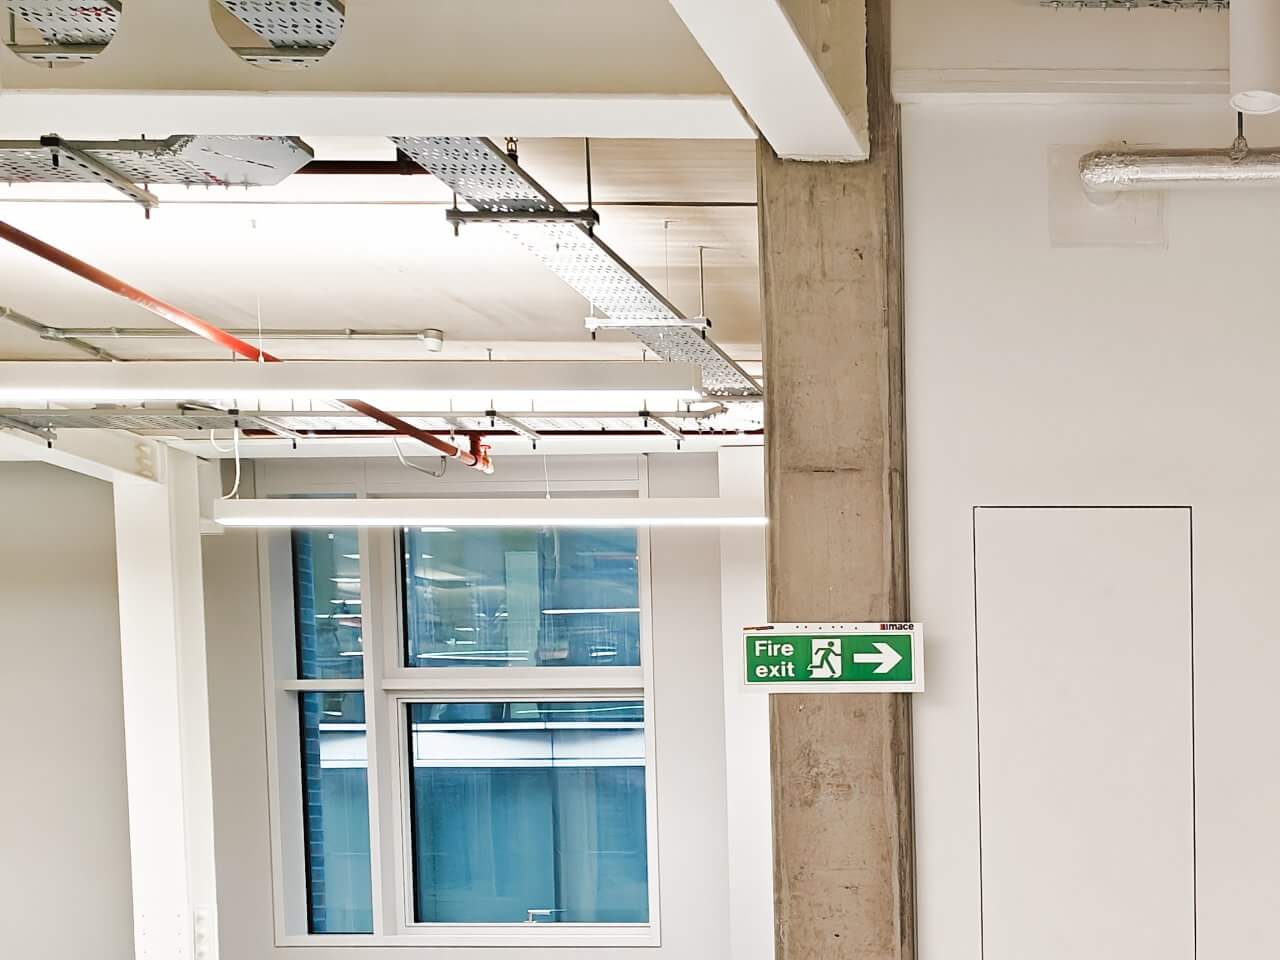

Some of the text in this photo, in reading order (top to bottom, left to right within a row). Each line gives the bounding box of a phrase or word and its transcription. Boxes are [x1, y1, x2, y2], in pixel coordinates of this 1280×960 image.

[889, 623, 914, 631] mace
[755, 640, 794, 657] Fire
[755, 661, 795, 678] exit
